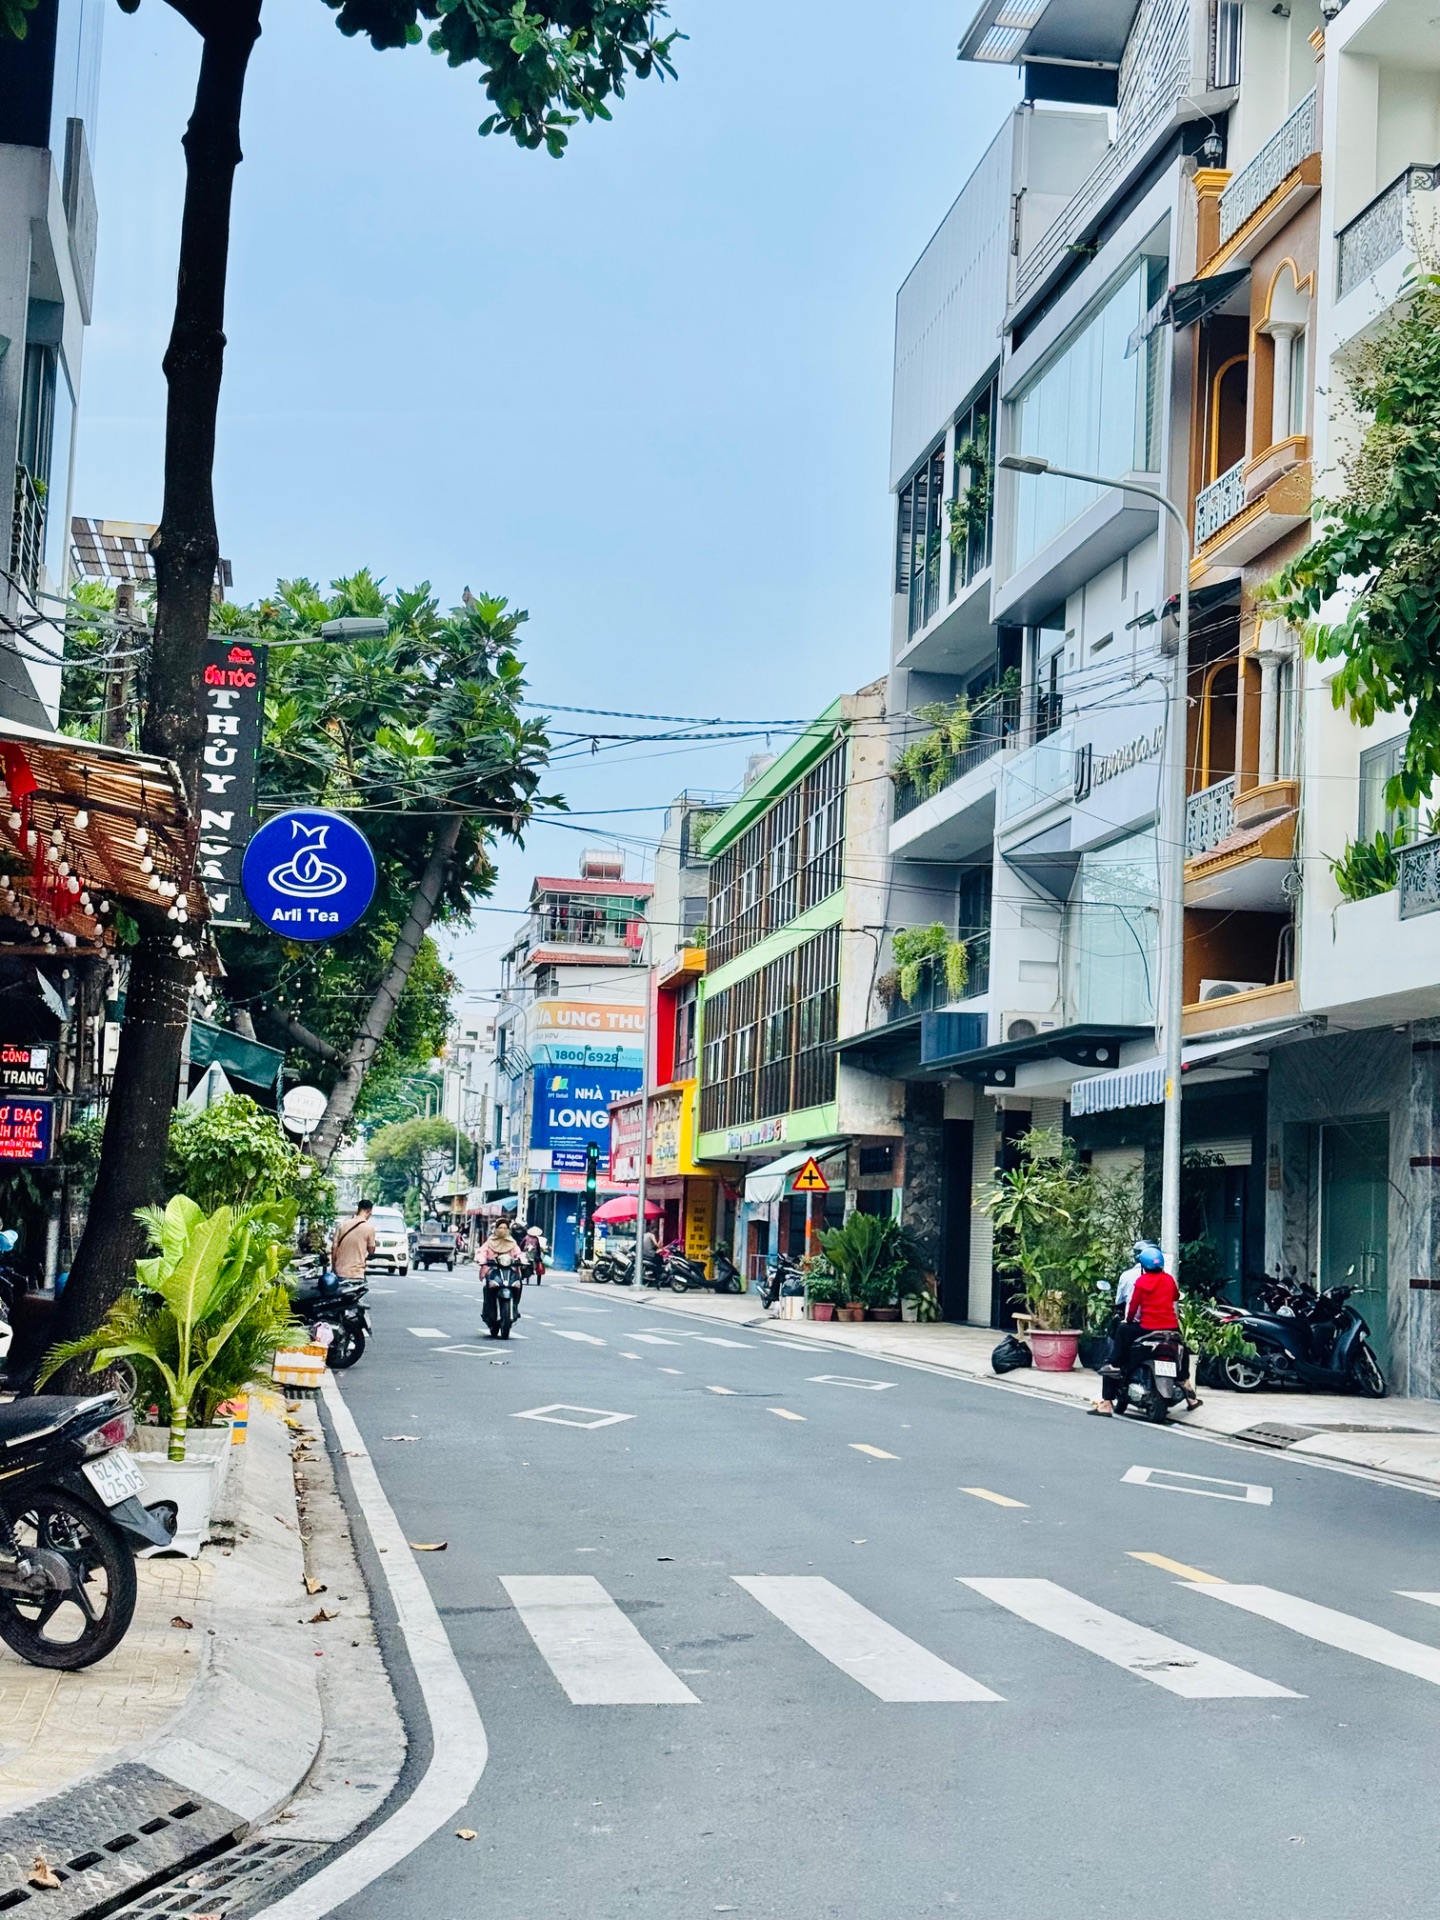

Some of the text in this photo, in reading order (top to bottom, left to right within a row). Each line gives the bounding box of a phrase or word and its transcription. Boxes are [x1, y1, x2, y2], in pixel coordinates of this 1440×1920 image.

[227, 667, 257, 688] TÓC
[201, 688, 241, 794] THỦY
[271, 907, 339, 923] Arli Tea
[557, 1010, 601, 1028] UNG
[2, 1047, 30, 1063] CÔNG
[555, 1050, 584, 1061] 1800
[588, 1052, 619, 1064] 6928
[3, 1070, 45, 1086] TRANG
[574, 1084, 604, 1101] NHÀ
[14, 1108, 43, 1124] BẠC
[548, 1109, 610, 1129] LONG
[14, 1122, 38, 1139] KHÁ
